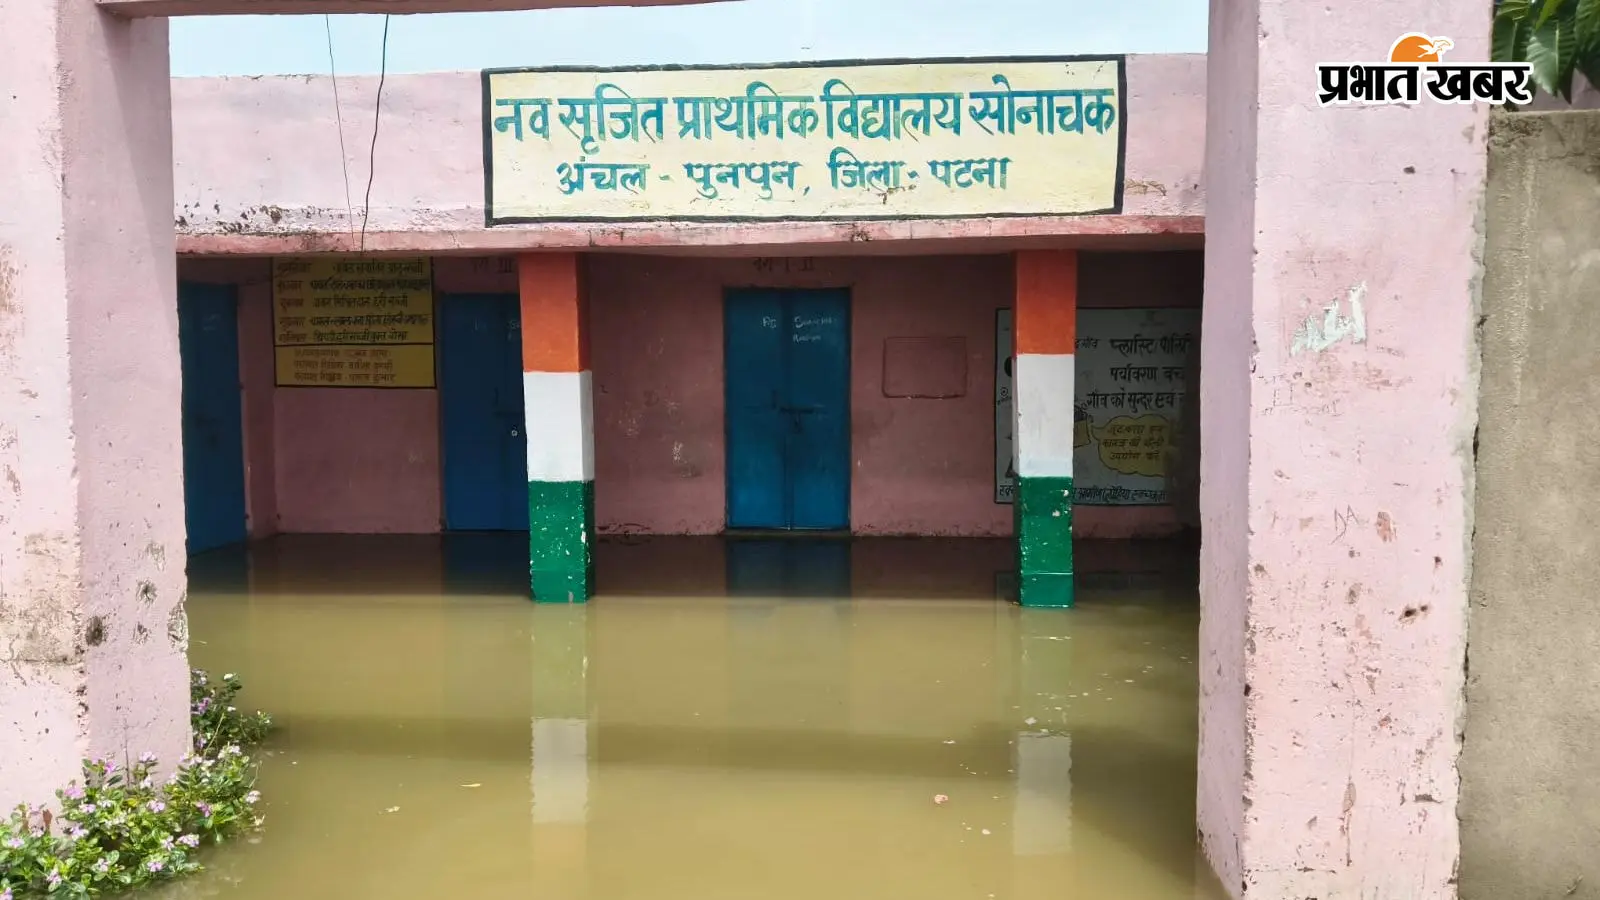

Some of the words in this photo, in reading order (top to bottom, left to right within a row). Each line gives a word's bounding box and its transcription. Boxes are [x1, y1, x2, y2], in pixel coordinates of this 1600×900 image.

[558, 83, 668, 155] सृजित
[672, 80, 819, 142] प्राथमिक
[819, 78, 965, 144] विद्यालय
[968, 73, 1116, 137] सोनाचक
[556, 155, 650, 195] अंचल
[927, 156, 1013, 190] पटना
